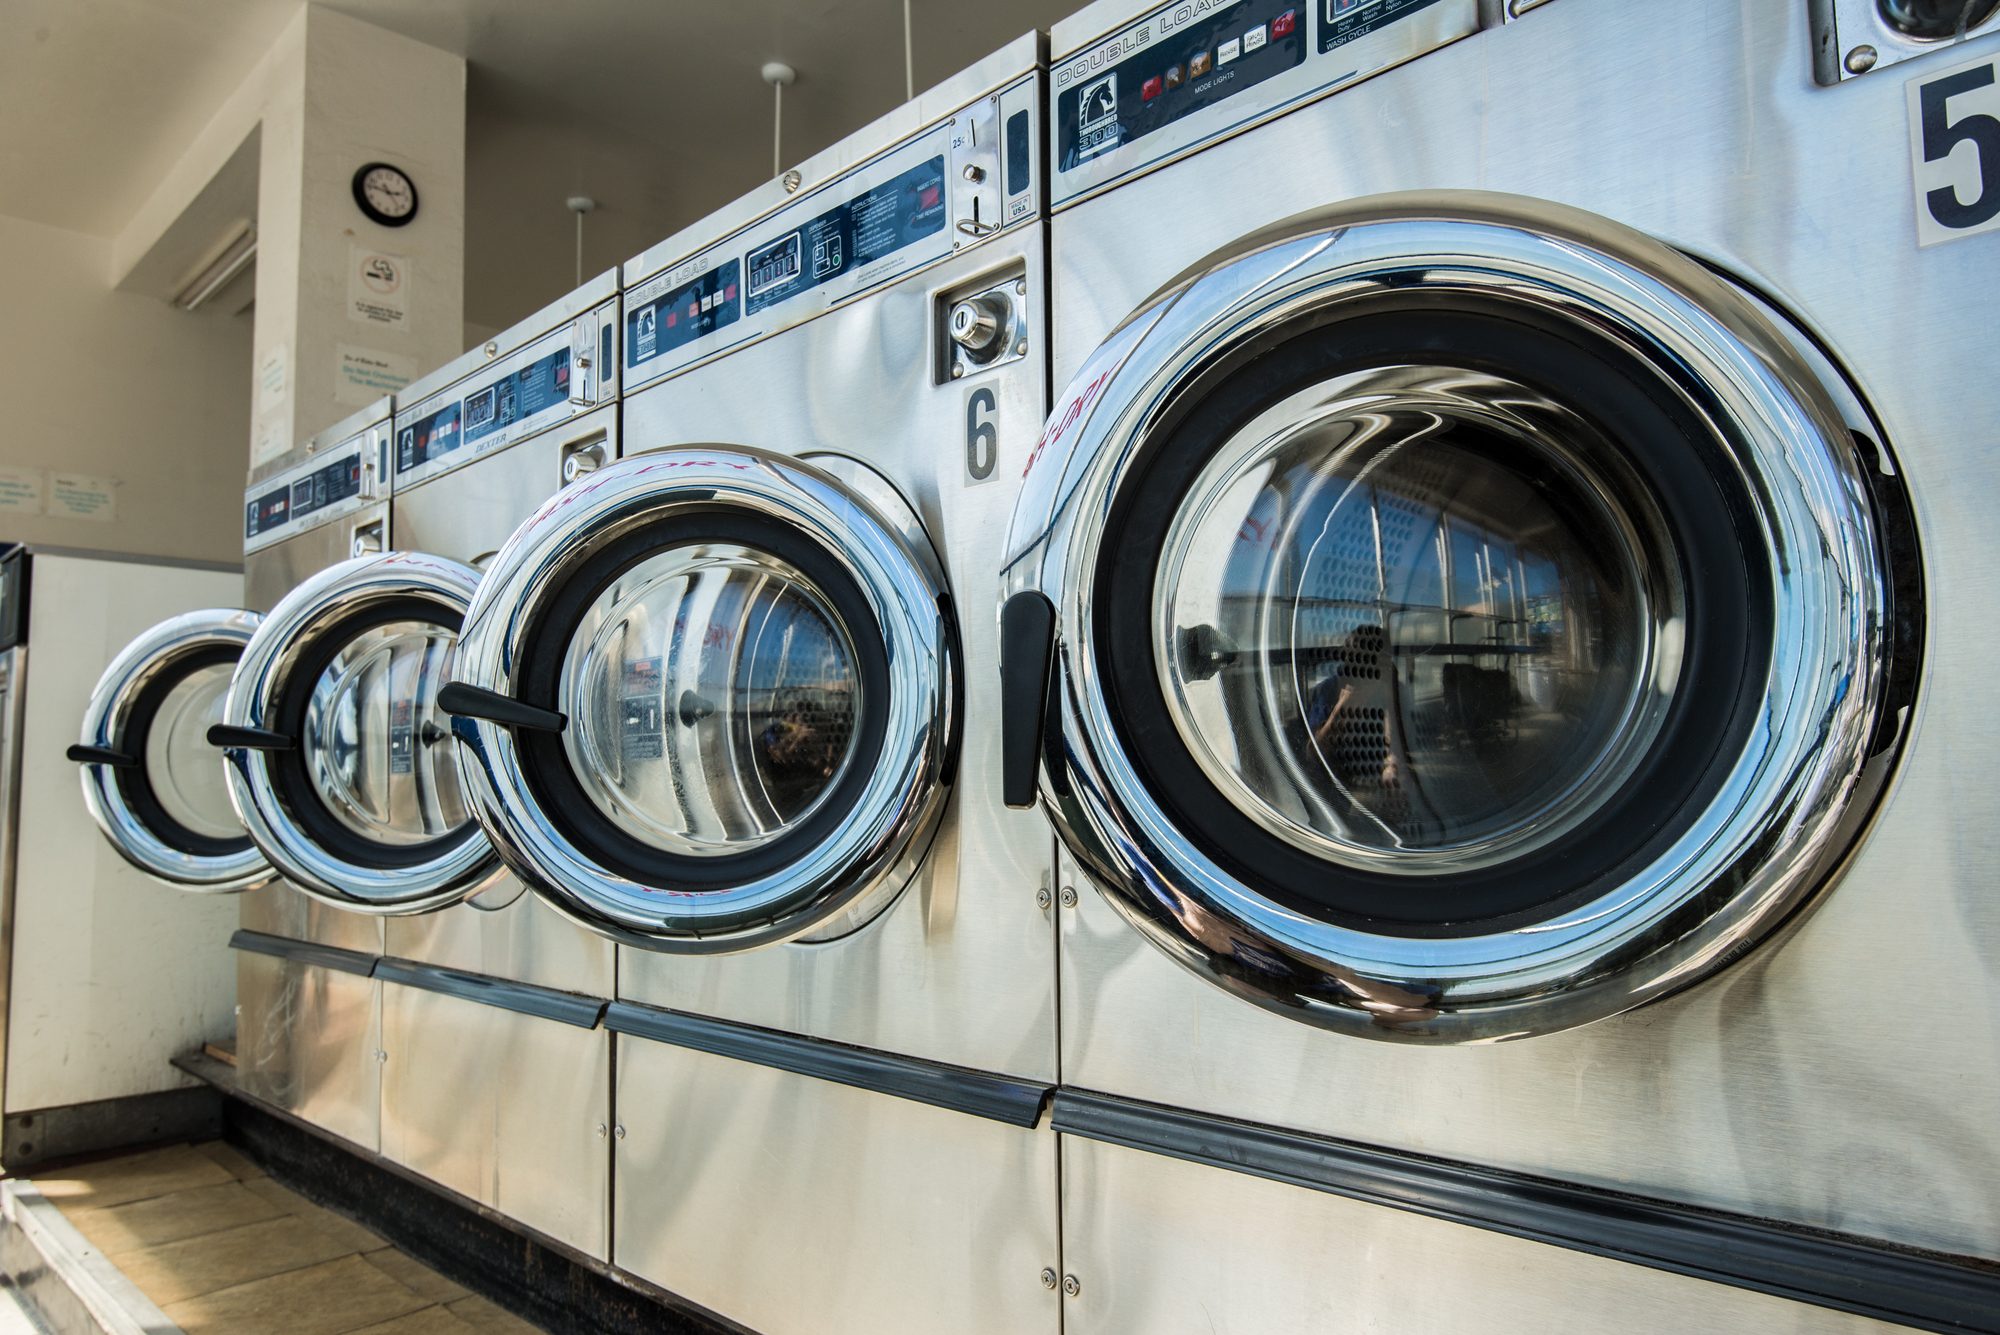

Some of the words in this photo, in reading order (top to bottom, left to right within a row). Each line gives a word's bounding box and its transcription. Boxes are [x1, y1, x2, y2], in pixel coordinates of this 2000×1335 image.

[1362, 4, 1382, 16] Normal
[1362, 11, 1378, 21] Wash
[1337, 18, 1354, 28] Heavy
[1337, 25, 1350, 33] Duty
[1326, 35, 1347, 50] WASH
[1347, 25, 1371, 40] CYCLE
[1057, 26, 1150, 88] DOUBLE
[1194, 78, 1212, 94] MODE
[1213, 70, 1235, 86] LIGHTS
[1079, 122, 1118, 150] 300
[1920, 62, 2000, 229] 5
[1012, 205, 1026, 216] USA
[627, 276, 672, 309] DOUBLE
[676, 258, 708, 284] LOAD
[475, 434, 507, 453] DEXTER
[967, 387, 997, 480] 6
